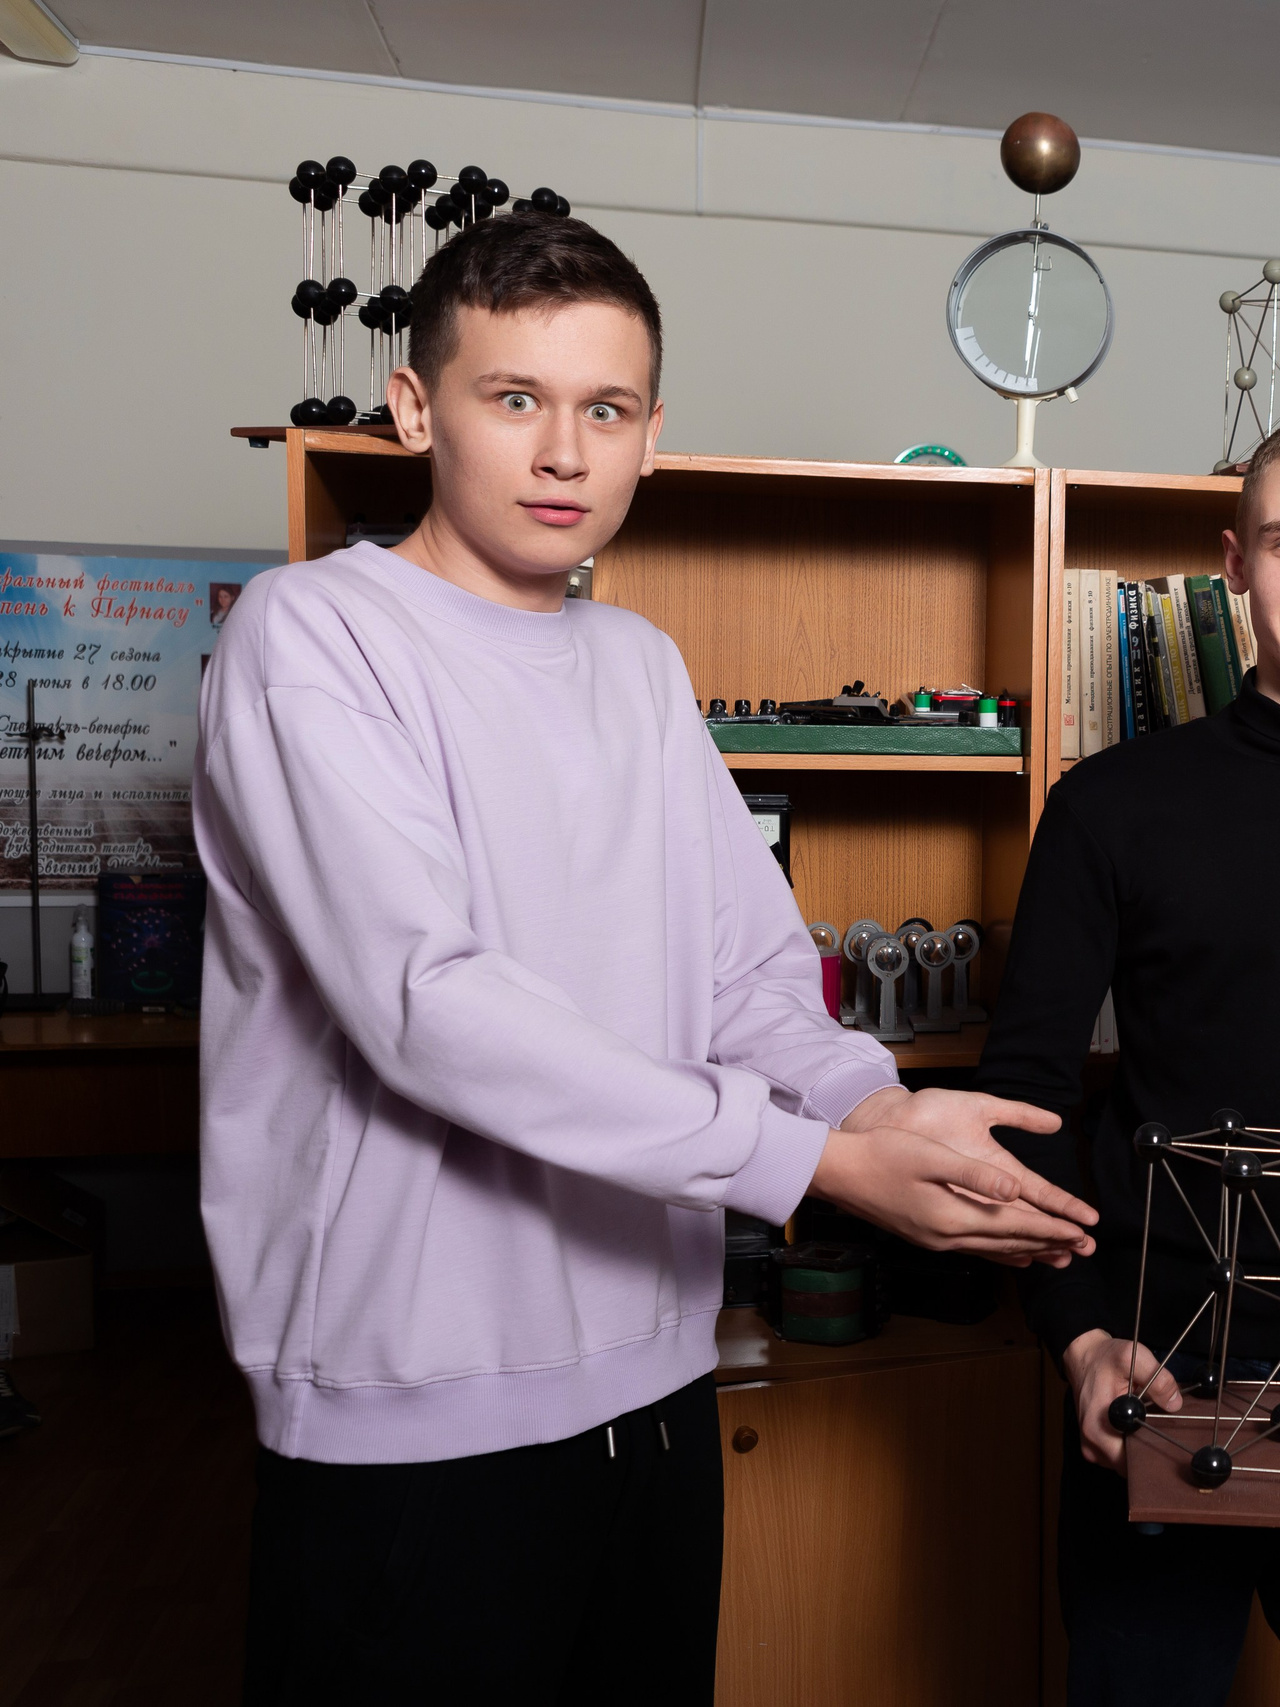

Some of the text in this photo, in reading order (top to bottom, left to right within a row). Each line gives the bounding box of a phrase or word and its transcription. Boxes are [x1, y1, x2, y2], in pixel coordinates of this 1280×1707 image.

[0, 567, 195, 596] ральный фестиваль
[0, 602, 49, 617] пень
[63, 594, 77, 618] к
[1128, 590, 1139, 629] Физика
[73, 643, 102, 665] 27
[110, 647, 162, 663] сезона
[1106, 643, 1112, 652] ПО
[82, 676, 91, 690] в
[101, 673, 158, 692] 18.00
[1133, 666, 1146, 732] дачник
[1106, 680, 1114, 747] МОНСТРАЦИОННЫЕ
[1178, 699, 1187, 724] НИК
[0, 714, 151, 741] Спетакль-бенефис
[48, 789, 85, 804] лица
[94, 790, 104, 800] и
[112, 789, 191, 801] исполните
[6, 838, 152, 858] рукводитель театра
[37, 858, 100, 874] Евгений
